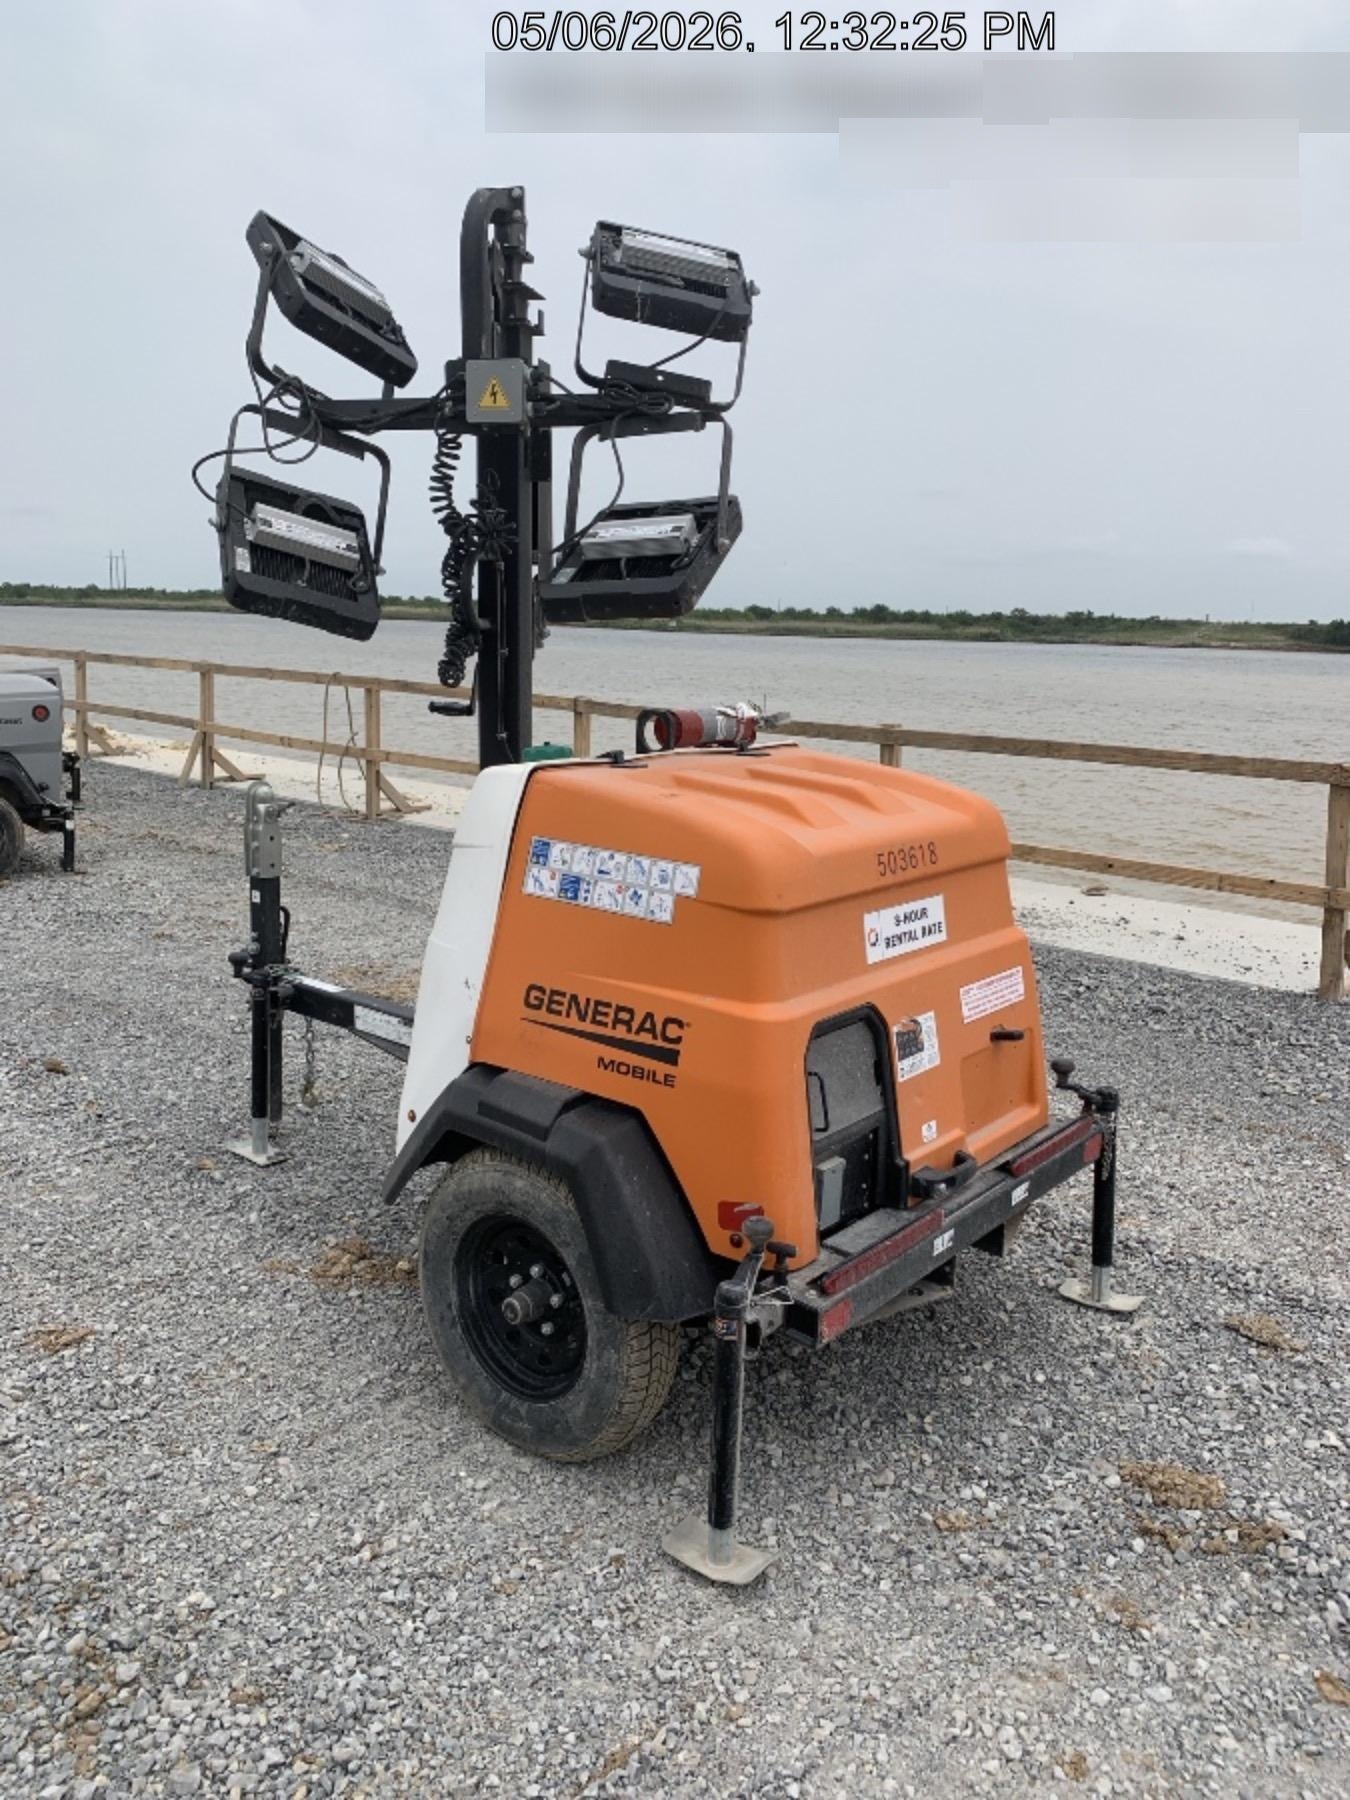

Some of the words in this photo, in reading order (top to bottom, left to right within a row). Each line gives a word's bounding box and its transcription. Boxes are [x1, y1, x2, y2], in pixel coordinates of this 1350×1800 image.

[877, 841, 938, 877] 503618
[884, 929, 919, 949] RENTAL
[921, 921, 943, 939] RATE
[523, 983, 685, 1045] GENERAC
[597, 1055, 677, 1089] MOBILE
